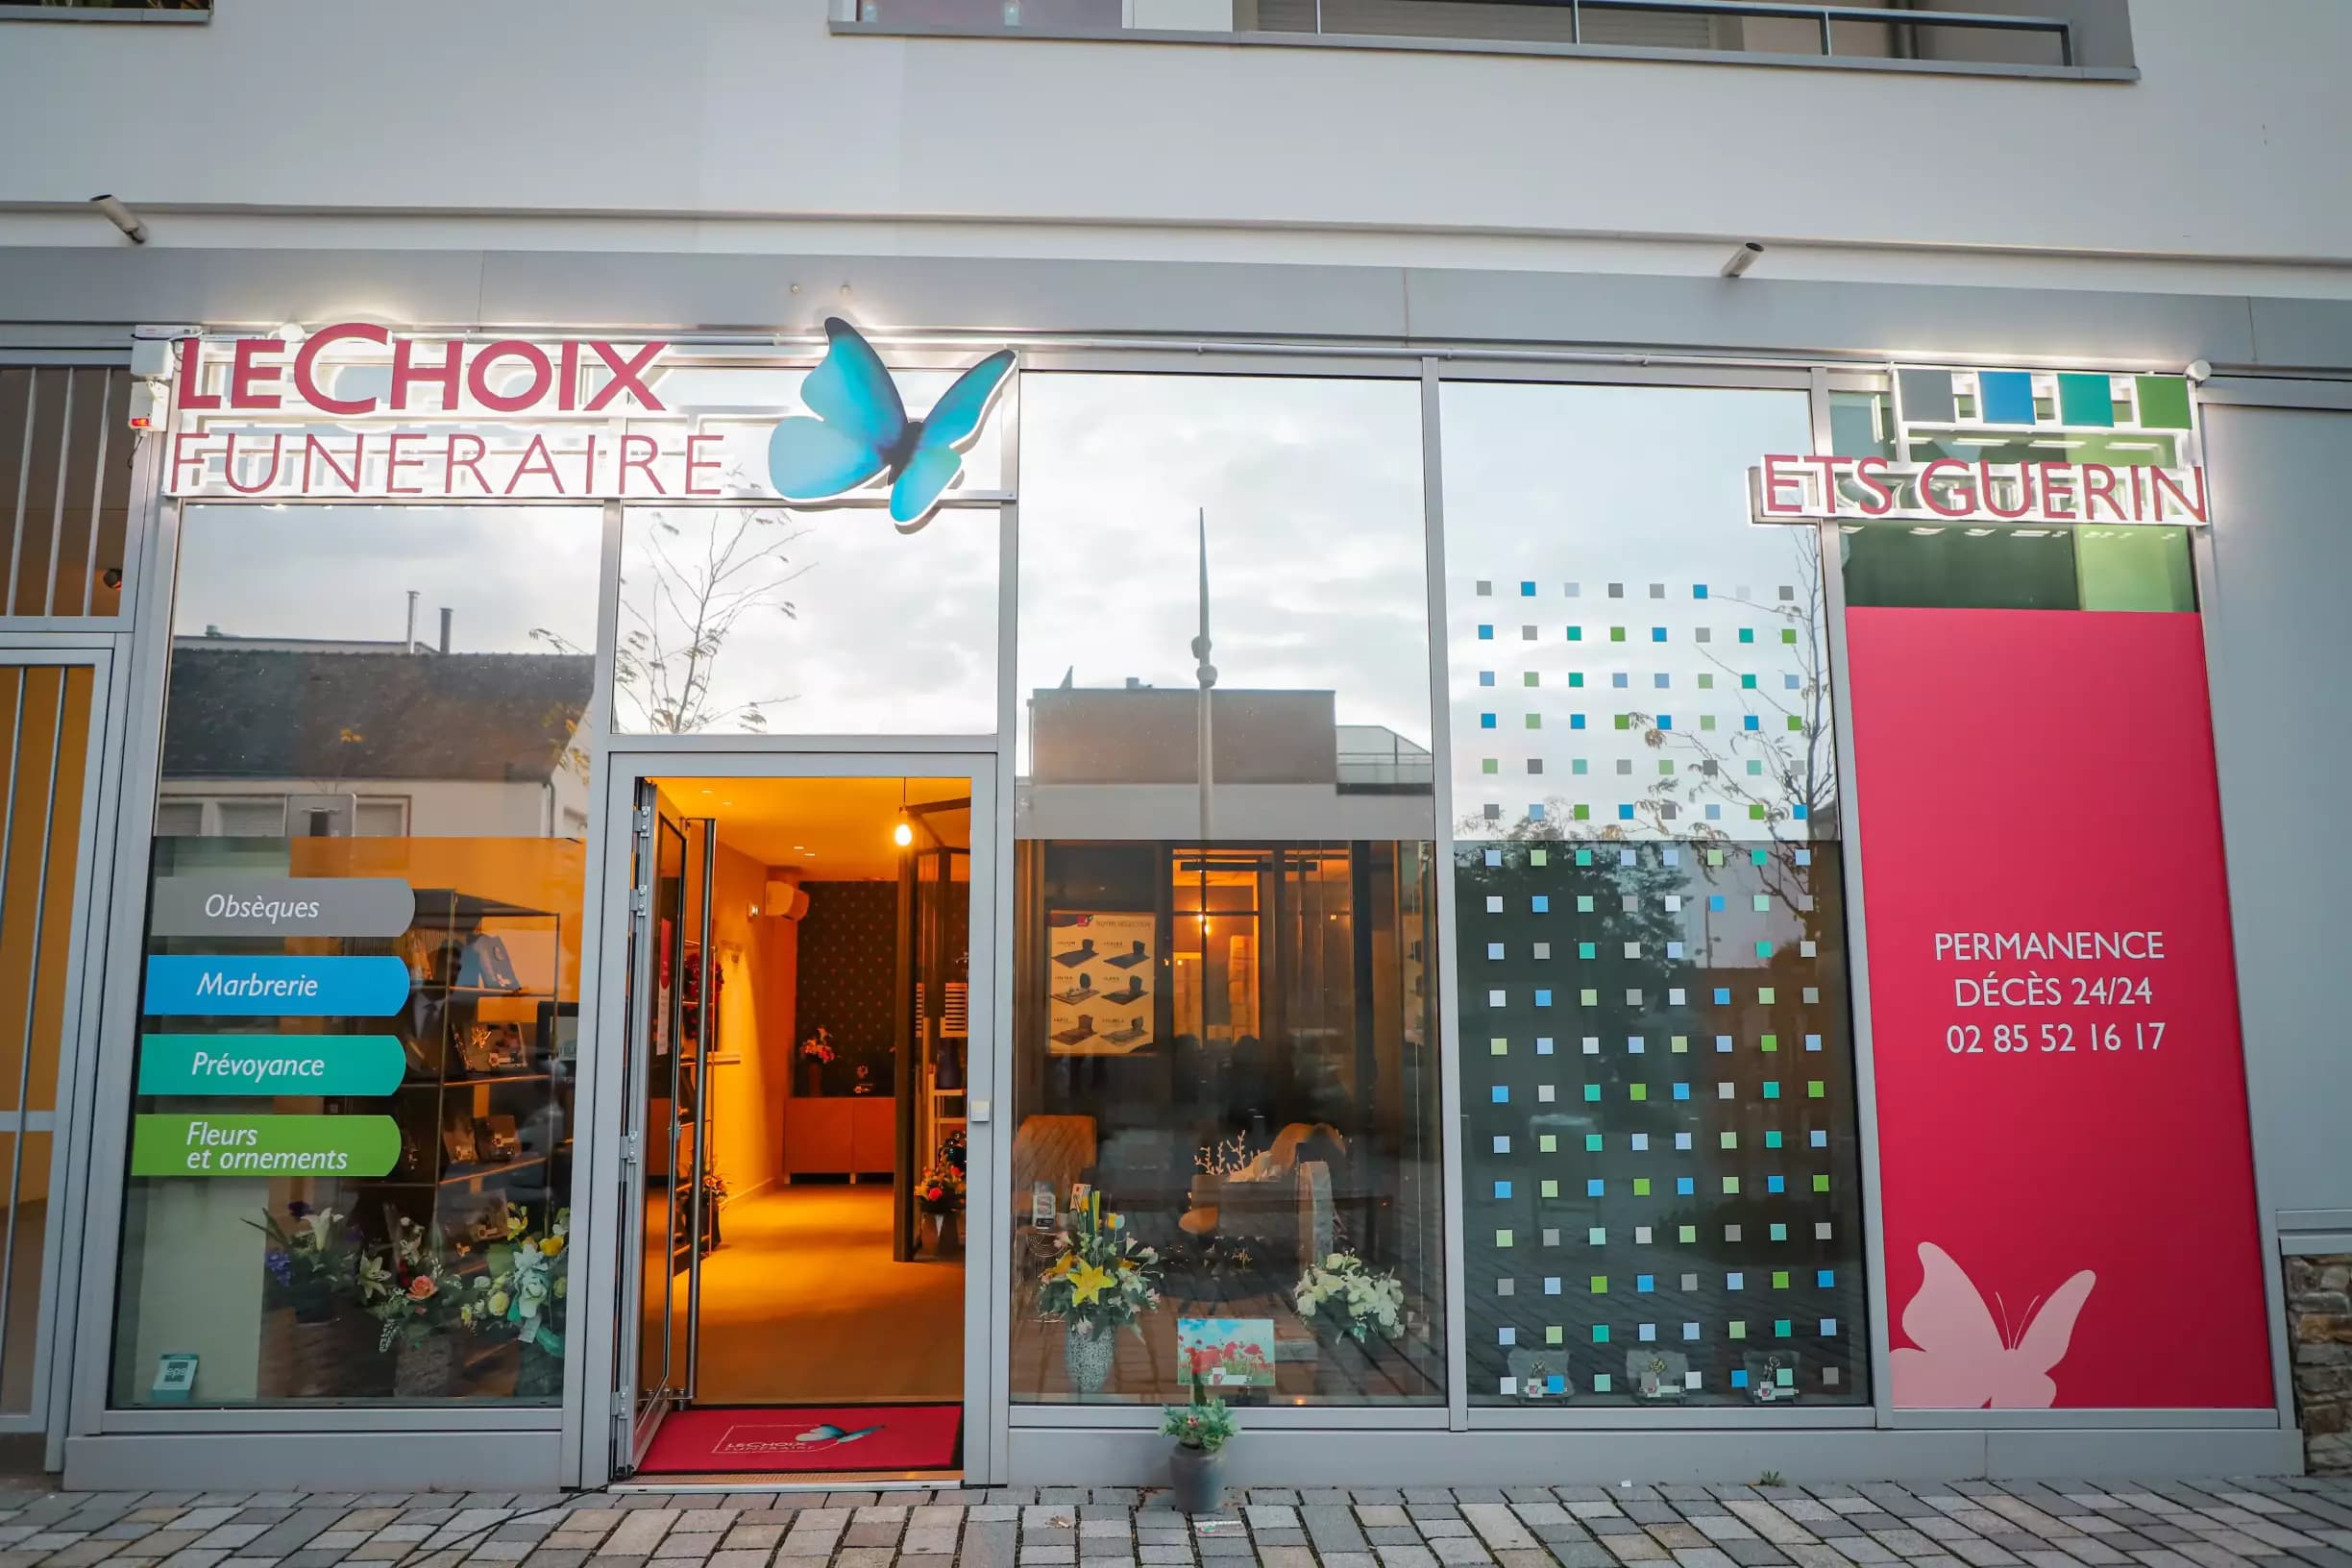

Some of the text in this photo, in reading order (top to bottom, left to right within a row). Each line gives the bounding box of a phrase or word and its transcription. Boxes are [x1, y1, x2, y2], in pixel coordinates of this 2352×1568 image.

[171, 431, 724, 495] FUNERAIRE
[1764, 454, 2207, 523] ETS GUERIN
[205, 894, 320, 925] Obsèques
[1935, 931, 2166, 961] PERMANENCE
[197, 972, 318, 996] Marbrerie
[1954, 970, 2153, 1007] DÉCÈS 24/24
[1946, 1022, 2167, 1054] 02 85 52 16 17
[191, 1051, 325, 1083] Prévoyance
[186, 1121, 258, 1146] Fleurs
[186, 1149, 348, 1170] et ornements
